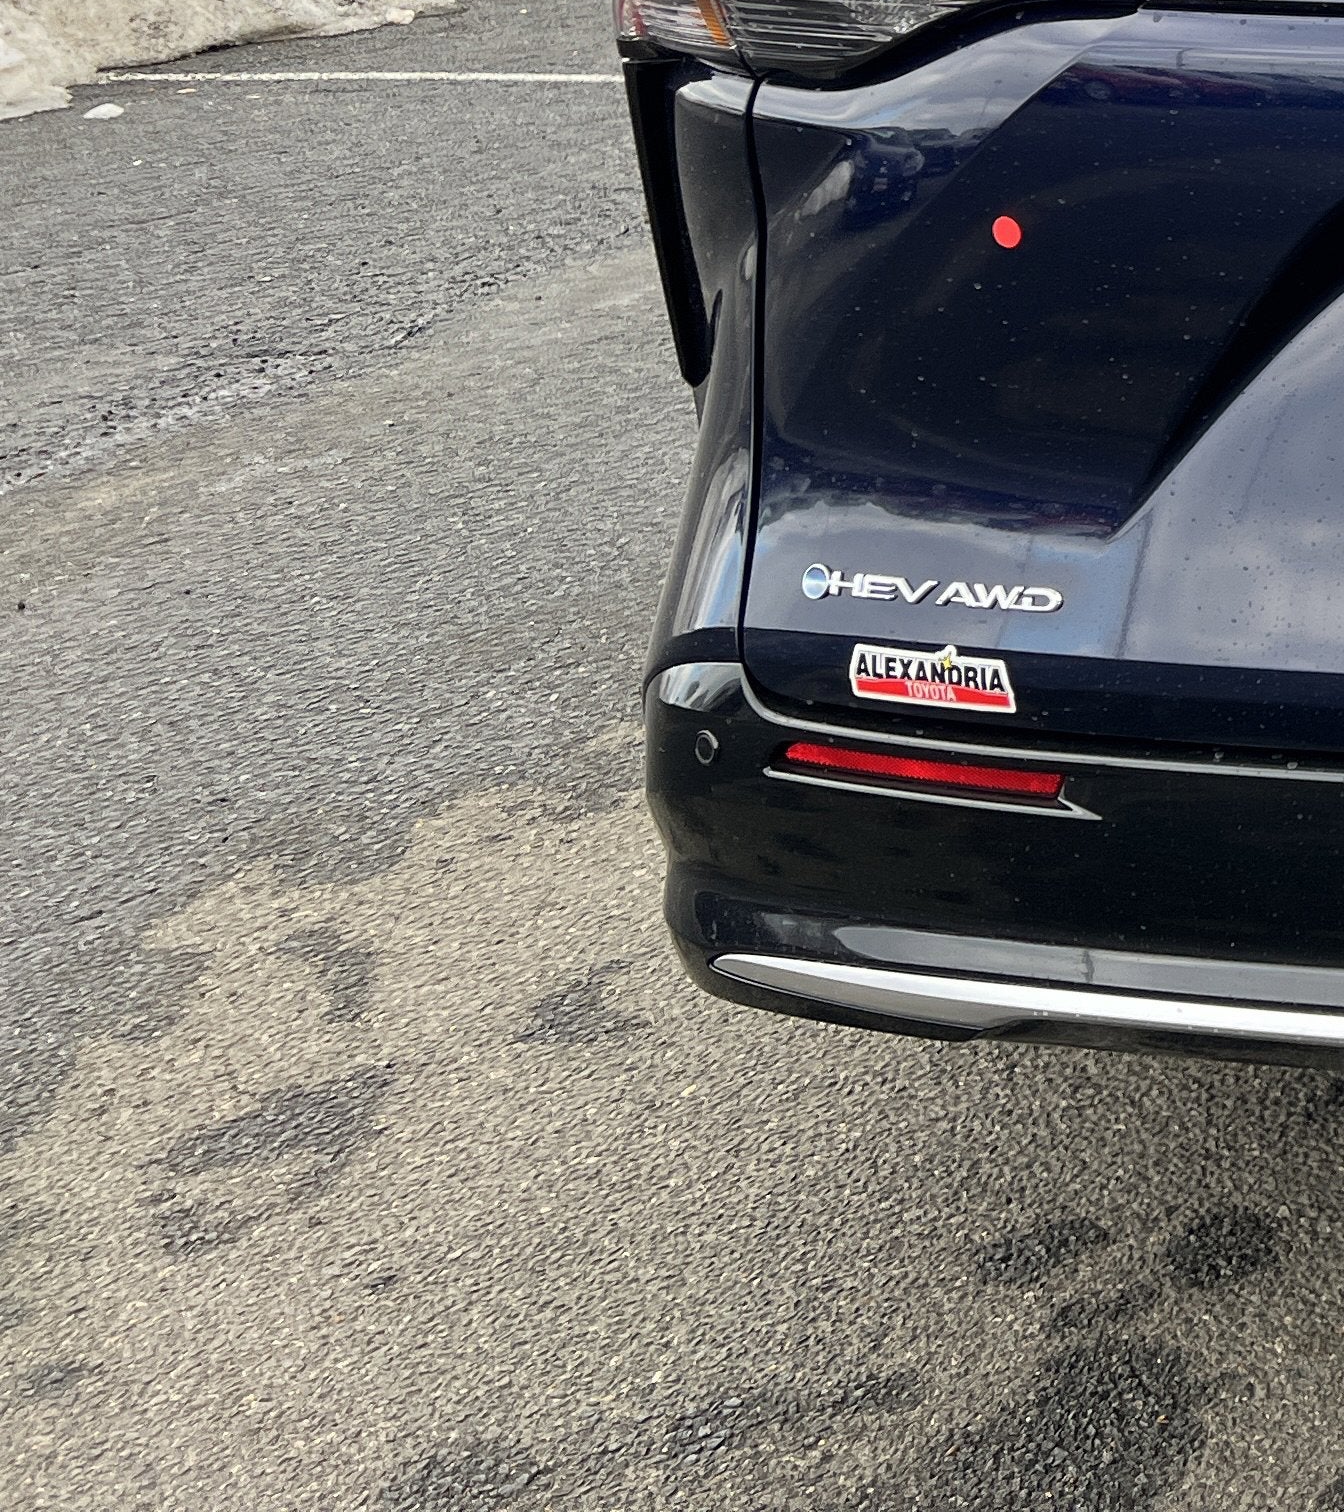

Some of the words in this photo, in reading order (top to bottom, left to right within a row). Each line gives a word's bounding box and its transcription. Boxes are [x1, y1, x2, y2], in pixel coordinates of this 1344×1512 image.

[829, 569, 938, 605] HEV
[935, 580, 1064, 613] AWD
[855, 652, 1006, 693] ALEXANDRIA
[904, 680, 957, 702] TOYOTA
